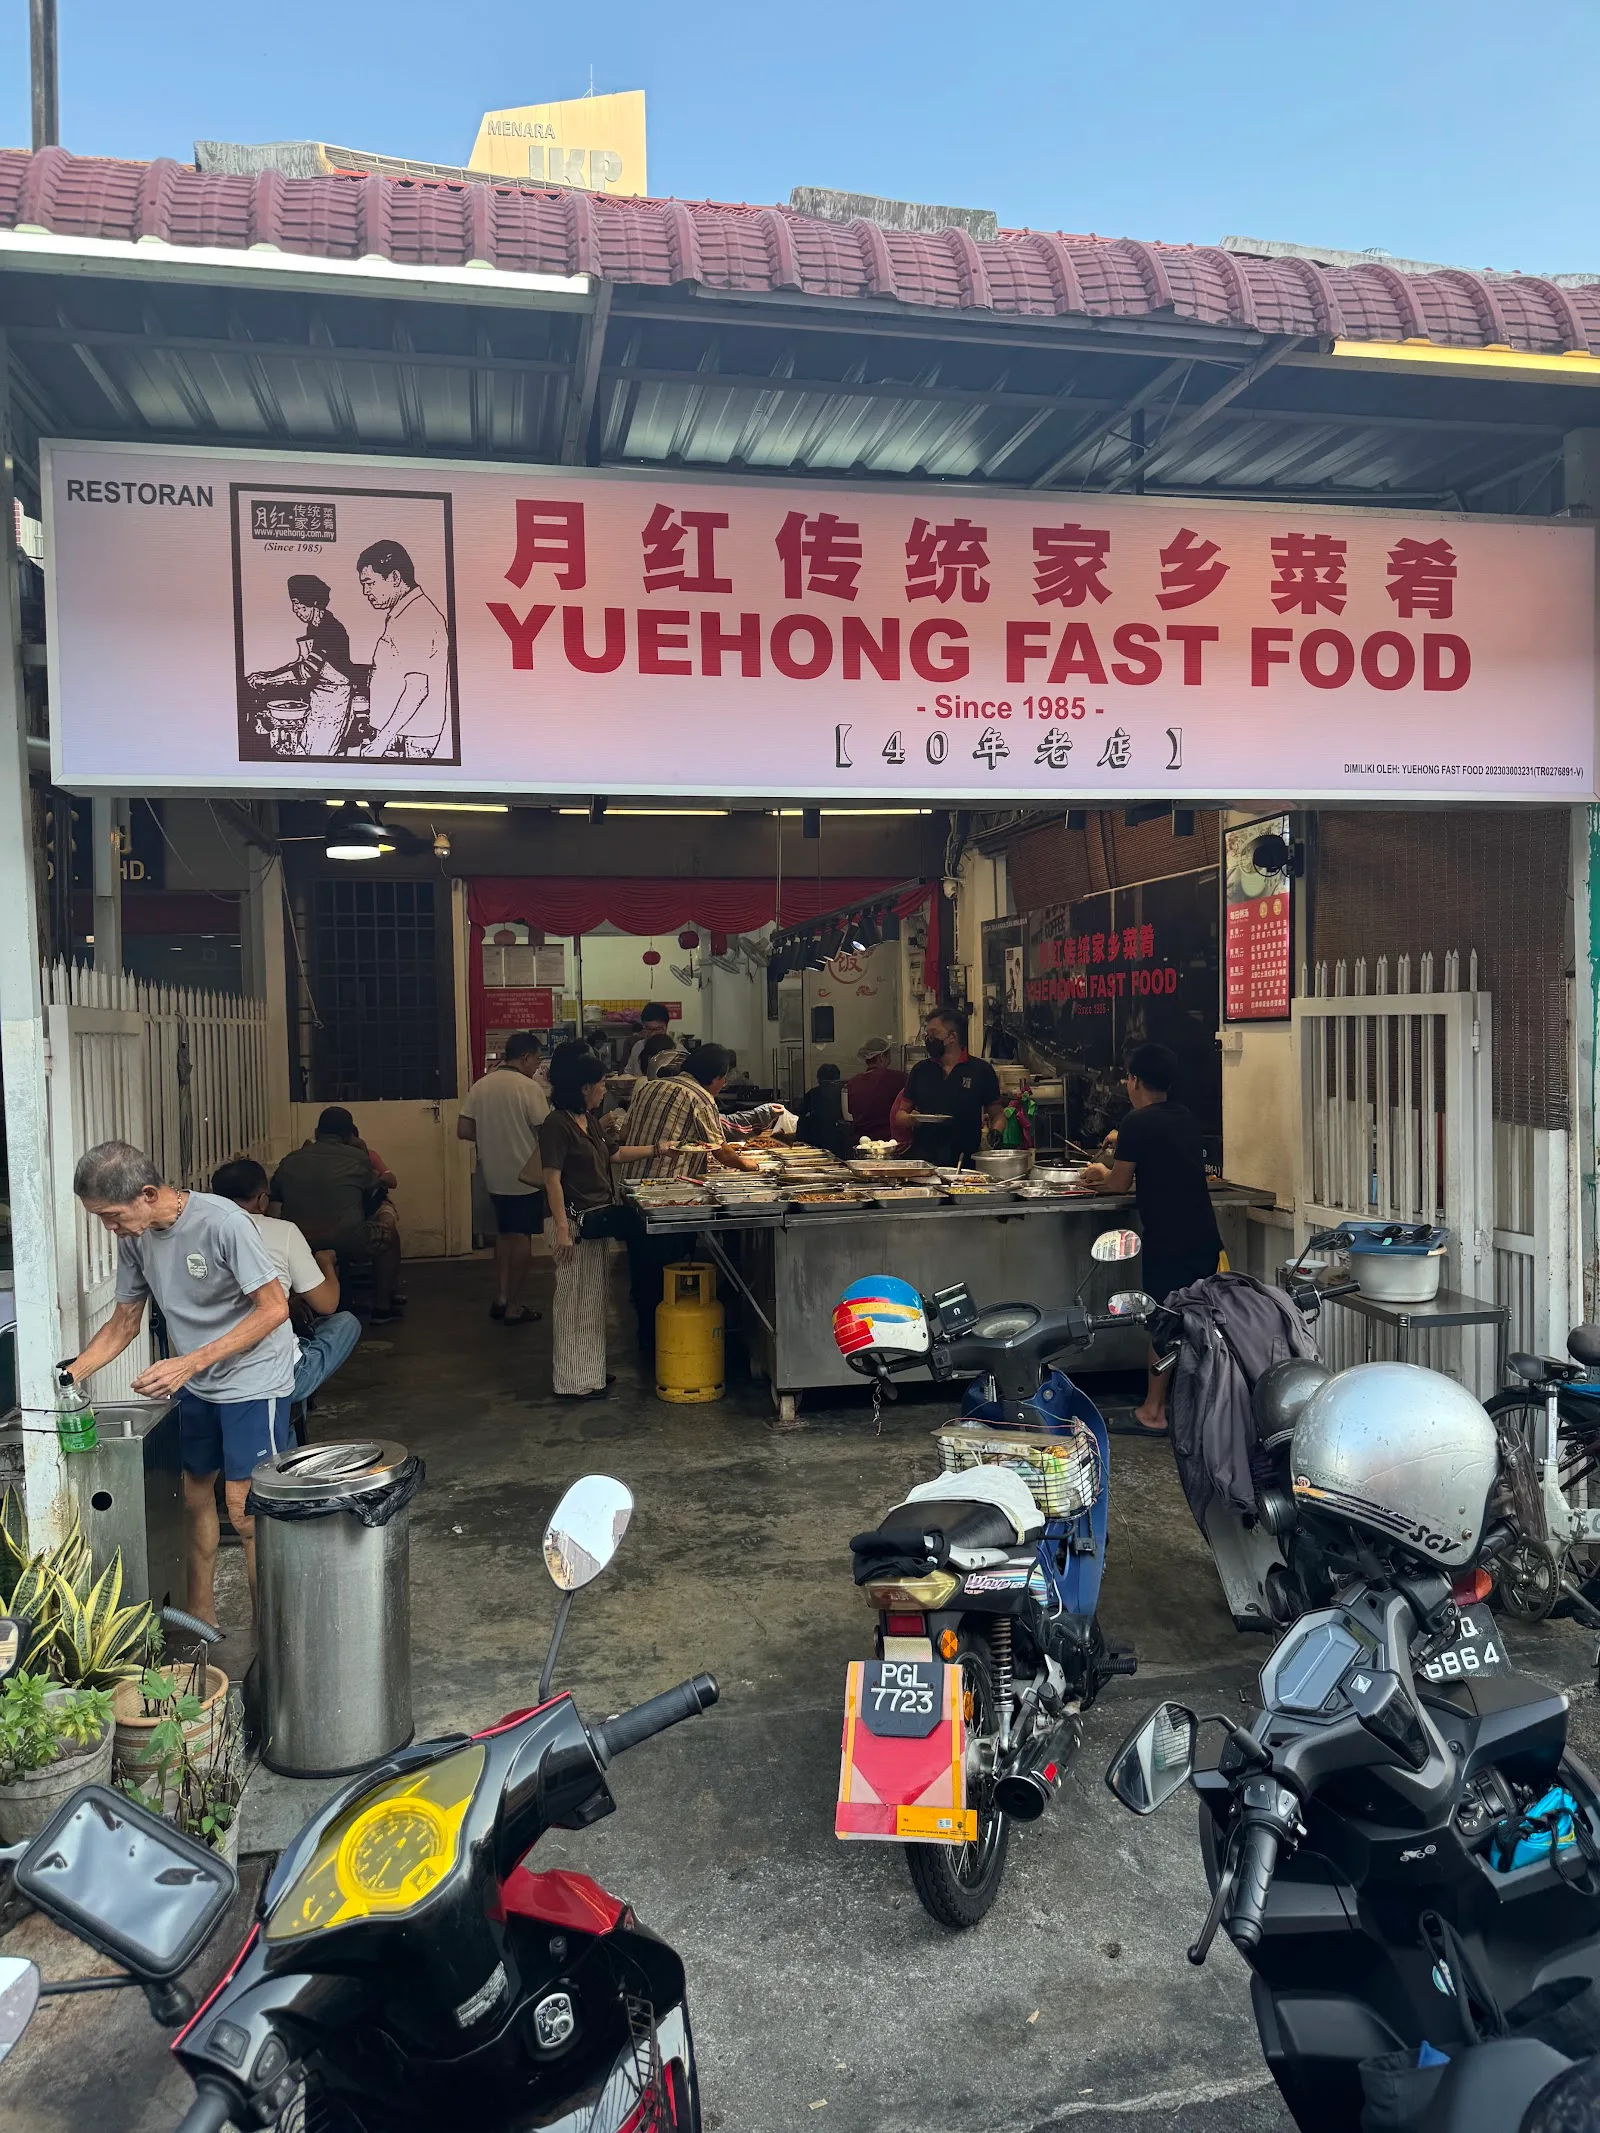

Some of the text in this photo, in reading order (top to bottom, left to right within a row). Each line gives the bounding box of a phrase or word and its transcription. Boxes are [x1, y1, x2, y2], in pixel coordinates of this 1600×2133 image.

[487, 120, 556, 139] MENARA
[528, 144, 623, 192] IKP
[67, 479, 213, 507] RESTORAN
[253, 528, 334, 541] www.yuehong.com.my
[264, 542, 323, 554] (Since 1985)
[504, 499, 1458, 620] 月红传统家乡菜肴
[486, 603, 1472, 692] YUEHONG FAST FOOD
[934, 694, 1012, 719] Since
[1023, 695, 1086, 720] 1985
[1344, 763, 1375, 774] DIMILIKI
[1377, 764, 1400, 774] OLEH:
[1402, 764, 1440, 775] YUEHONG
[1442, 765, 1461, 775] FAST
[1462, 765, 1484, 775] FOOD
[1089, 971, 1126, 999] FAST
[1131, 967, 1177, 997] FOOD
[1409, 1525, 1463, 1554] SGV
[965, 1572, 1011, 1591] Wave
[1425, 1642, 1500, 1679] 6864
[880, 1663, 929, 1689] PGL
[870, 1687, 934, 1714] 7723
